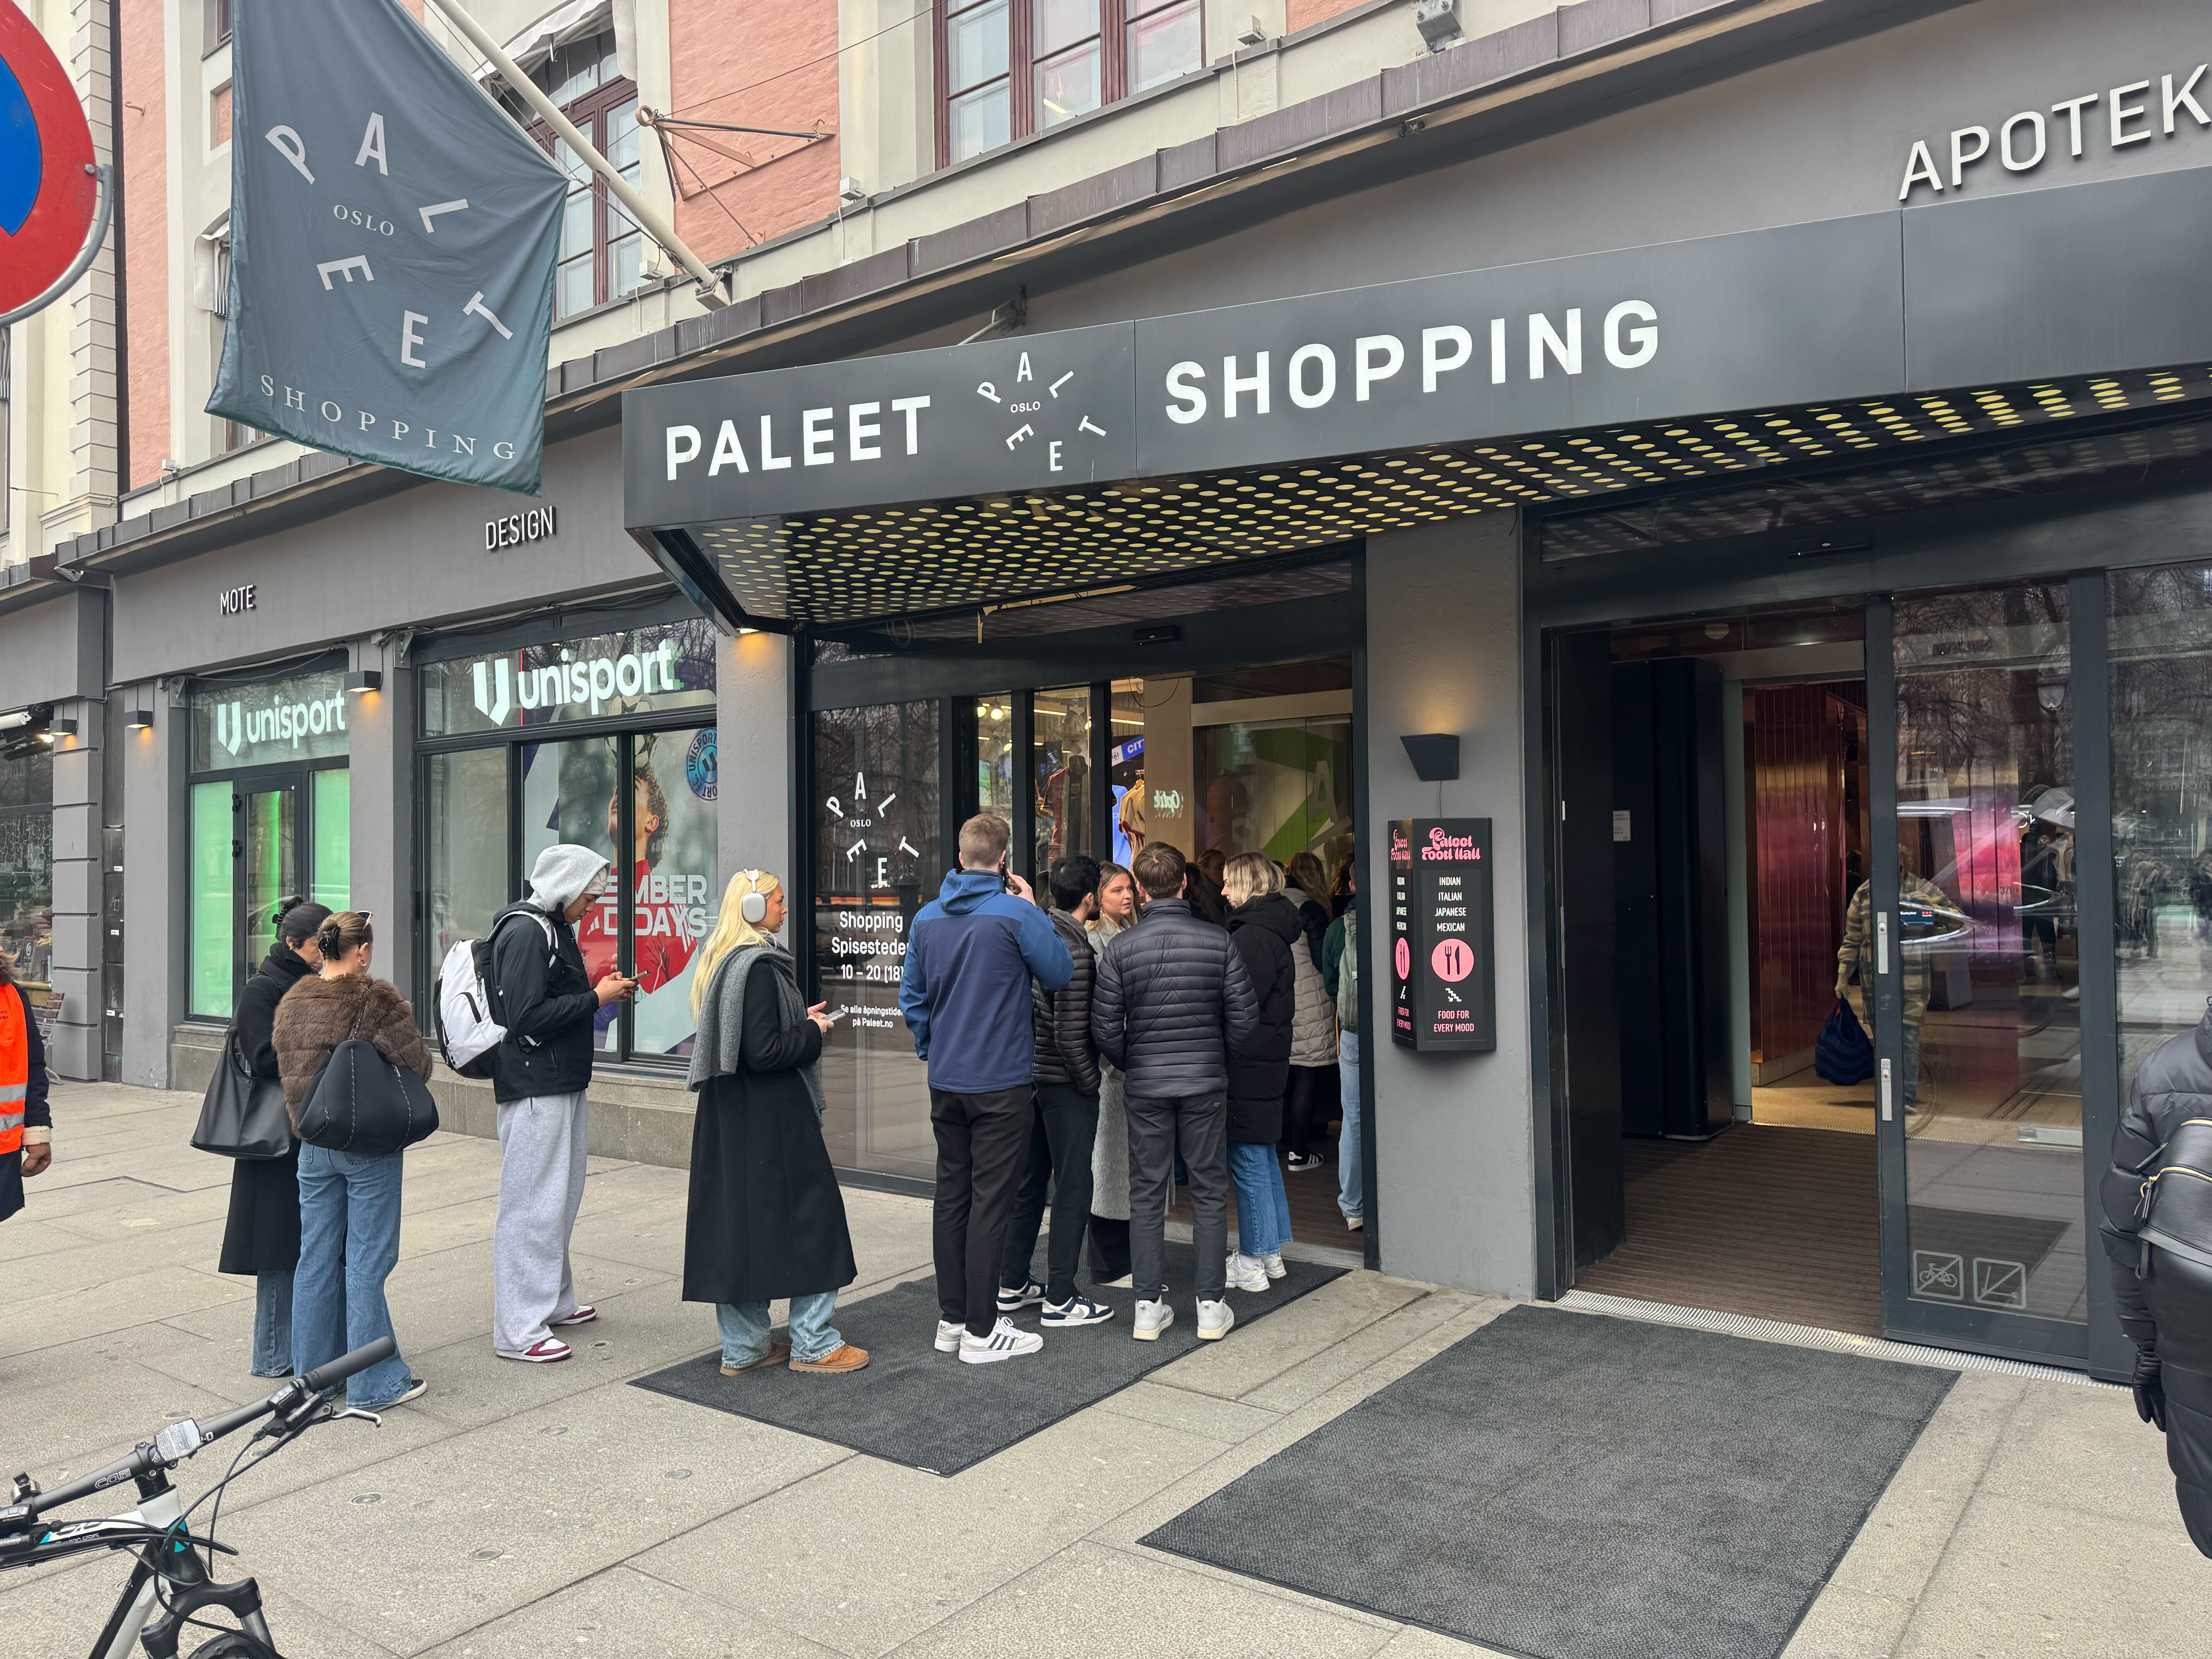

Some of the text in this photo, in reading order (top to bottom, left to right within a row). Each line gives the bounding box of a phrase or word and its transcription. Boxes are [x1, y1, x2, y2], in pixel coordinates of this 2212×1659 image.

[1899, 64, 2212, 202] APOTEK
[334, 204, 394, 236] OSLO
[666, 300, 1658, 481] PALEET SHOPPING
[1010, 400, 1041, 414] OSLO
[261, 375, 516, 460] SHOPPING
[486, 505, 553, 550] DESIGN
[220, 584, 254, 615] MOTE
[518, 639, 675, 715] unisport
[246, 688, 345, 749] unisport
[1127, 738, 1144, 754] CIT
[850, 819, 871, 828] OSLO
[1422, 847, 1453, 860] Food
[1439, 876, 1461, 886] INDIAN
[1438, 892, 1462, 901] ITALIAN
[1434, 907, 1467, 917] JAPANESE
[840, 911, 903, 933] Shopping
[1437, 922, 1465, 932] MEXICAN
[841, 964, 854, 979] 10
[866, 965, 881, 981] 20
[840, 1004, 849, 1013] Se
[850, 1005, 862, 1014] alle
[1438, 1010, 1470, 1019] FOOD FOR
[852, 1017, 893, 1028] på Paleet.no
[1434, 1023, 1475, 1032] EVERY MOOD
